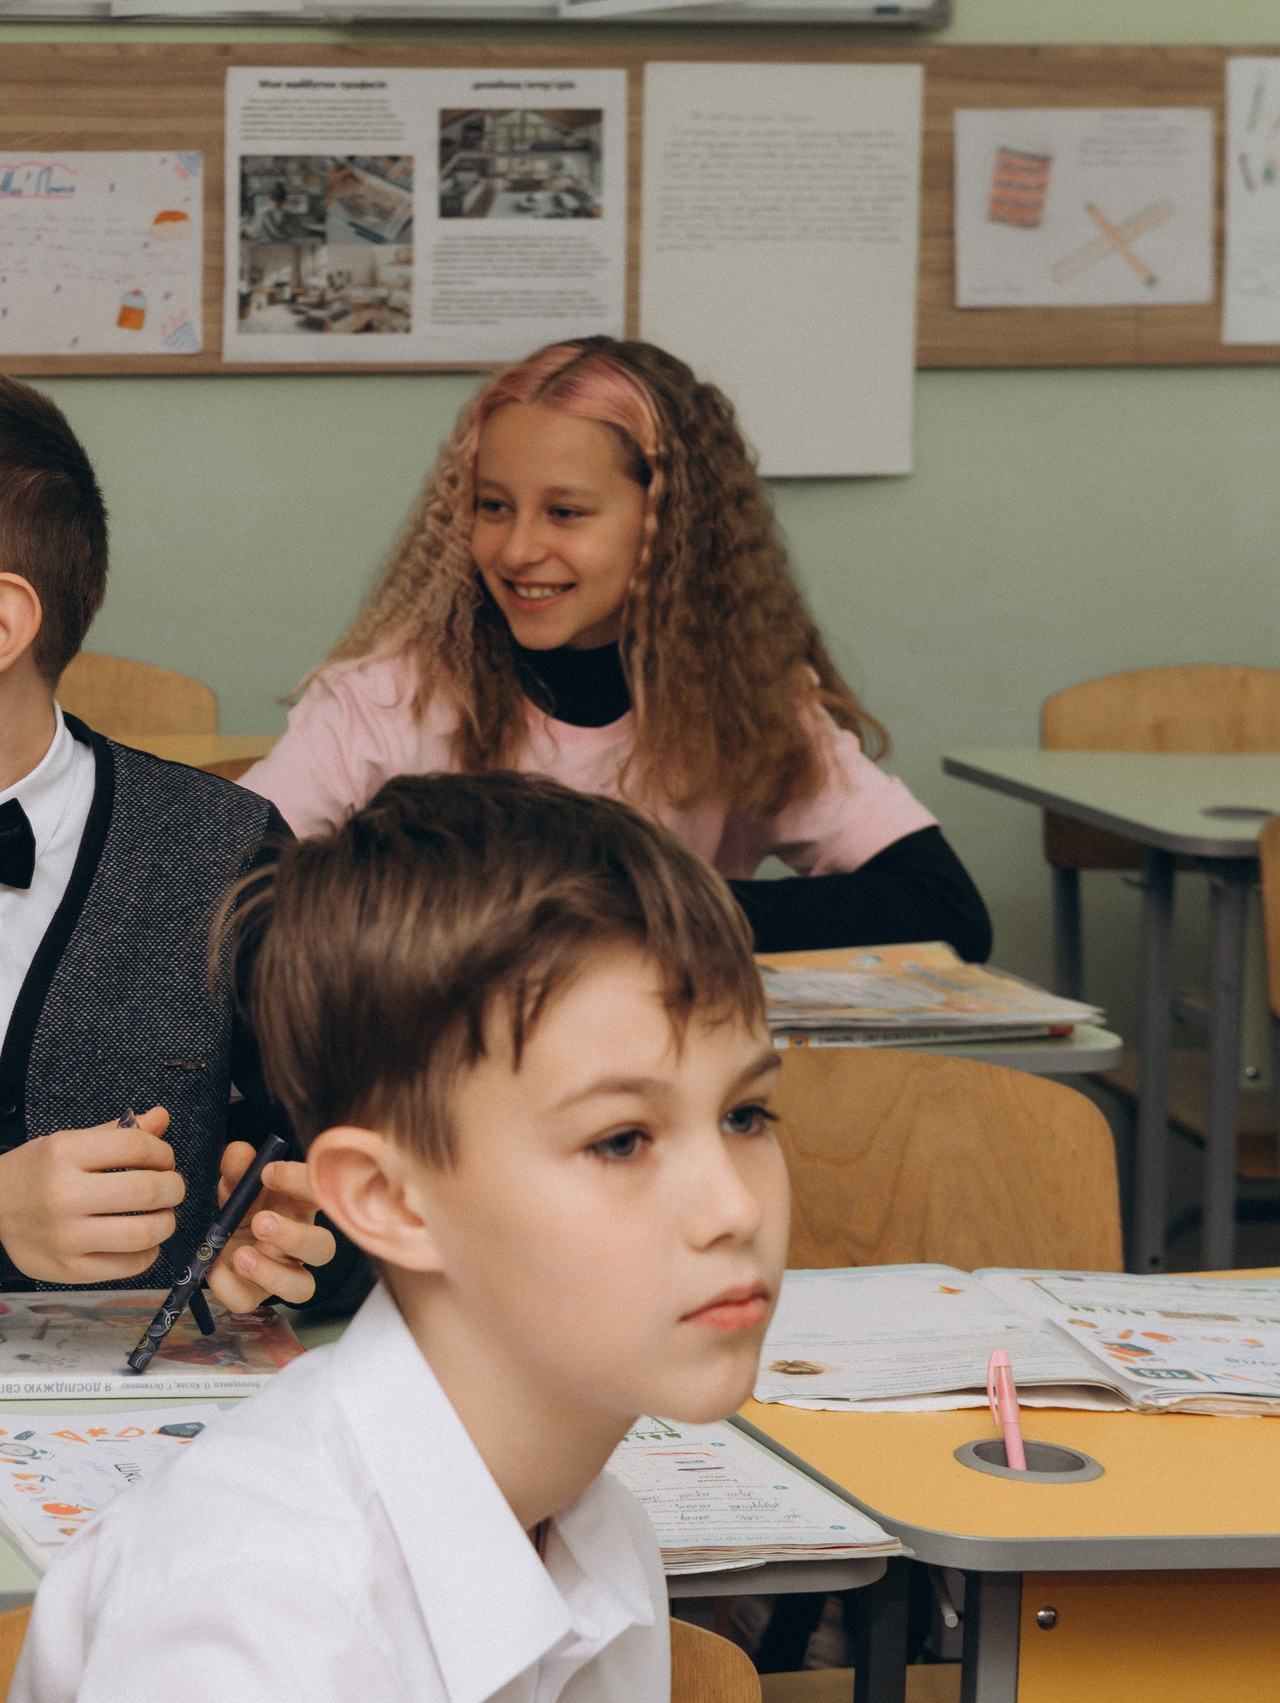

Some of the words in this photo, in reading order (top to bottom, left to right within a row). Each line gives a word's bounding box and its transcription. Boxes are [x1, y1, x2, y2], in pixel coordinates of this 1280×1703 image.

[1138, 1369, 1187, 1378] 123
[23, 1381, 101, 1394] ДОСЛІДЖУЮ
[103, 1380, 113, 1392] Я
